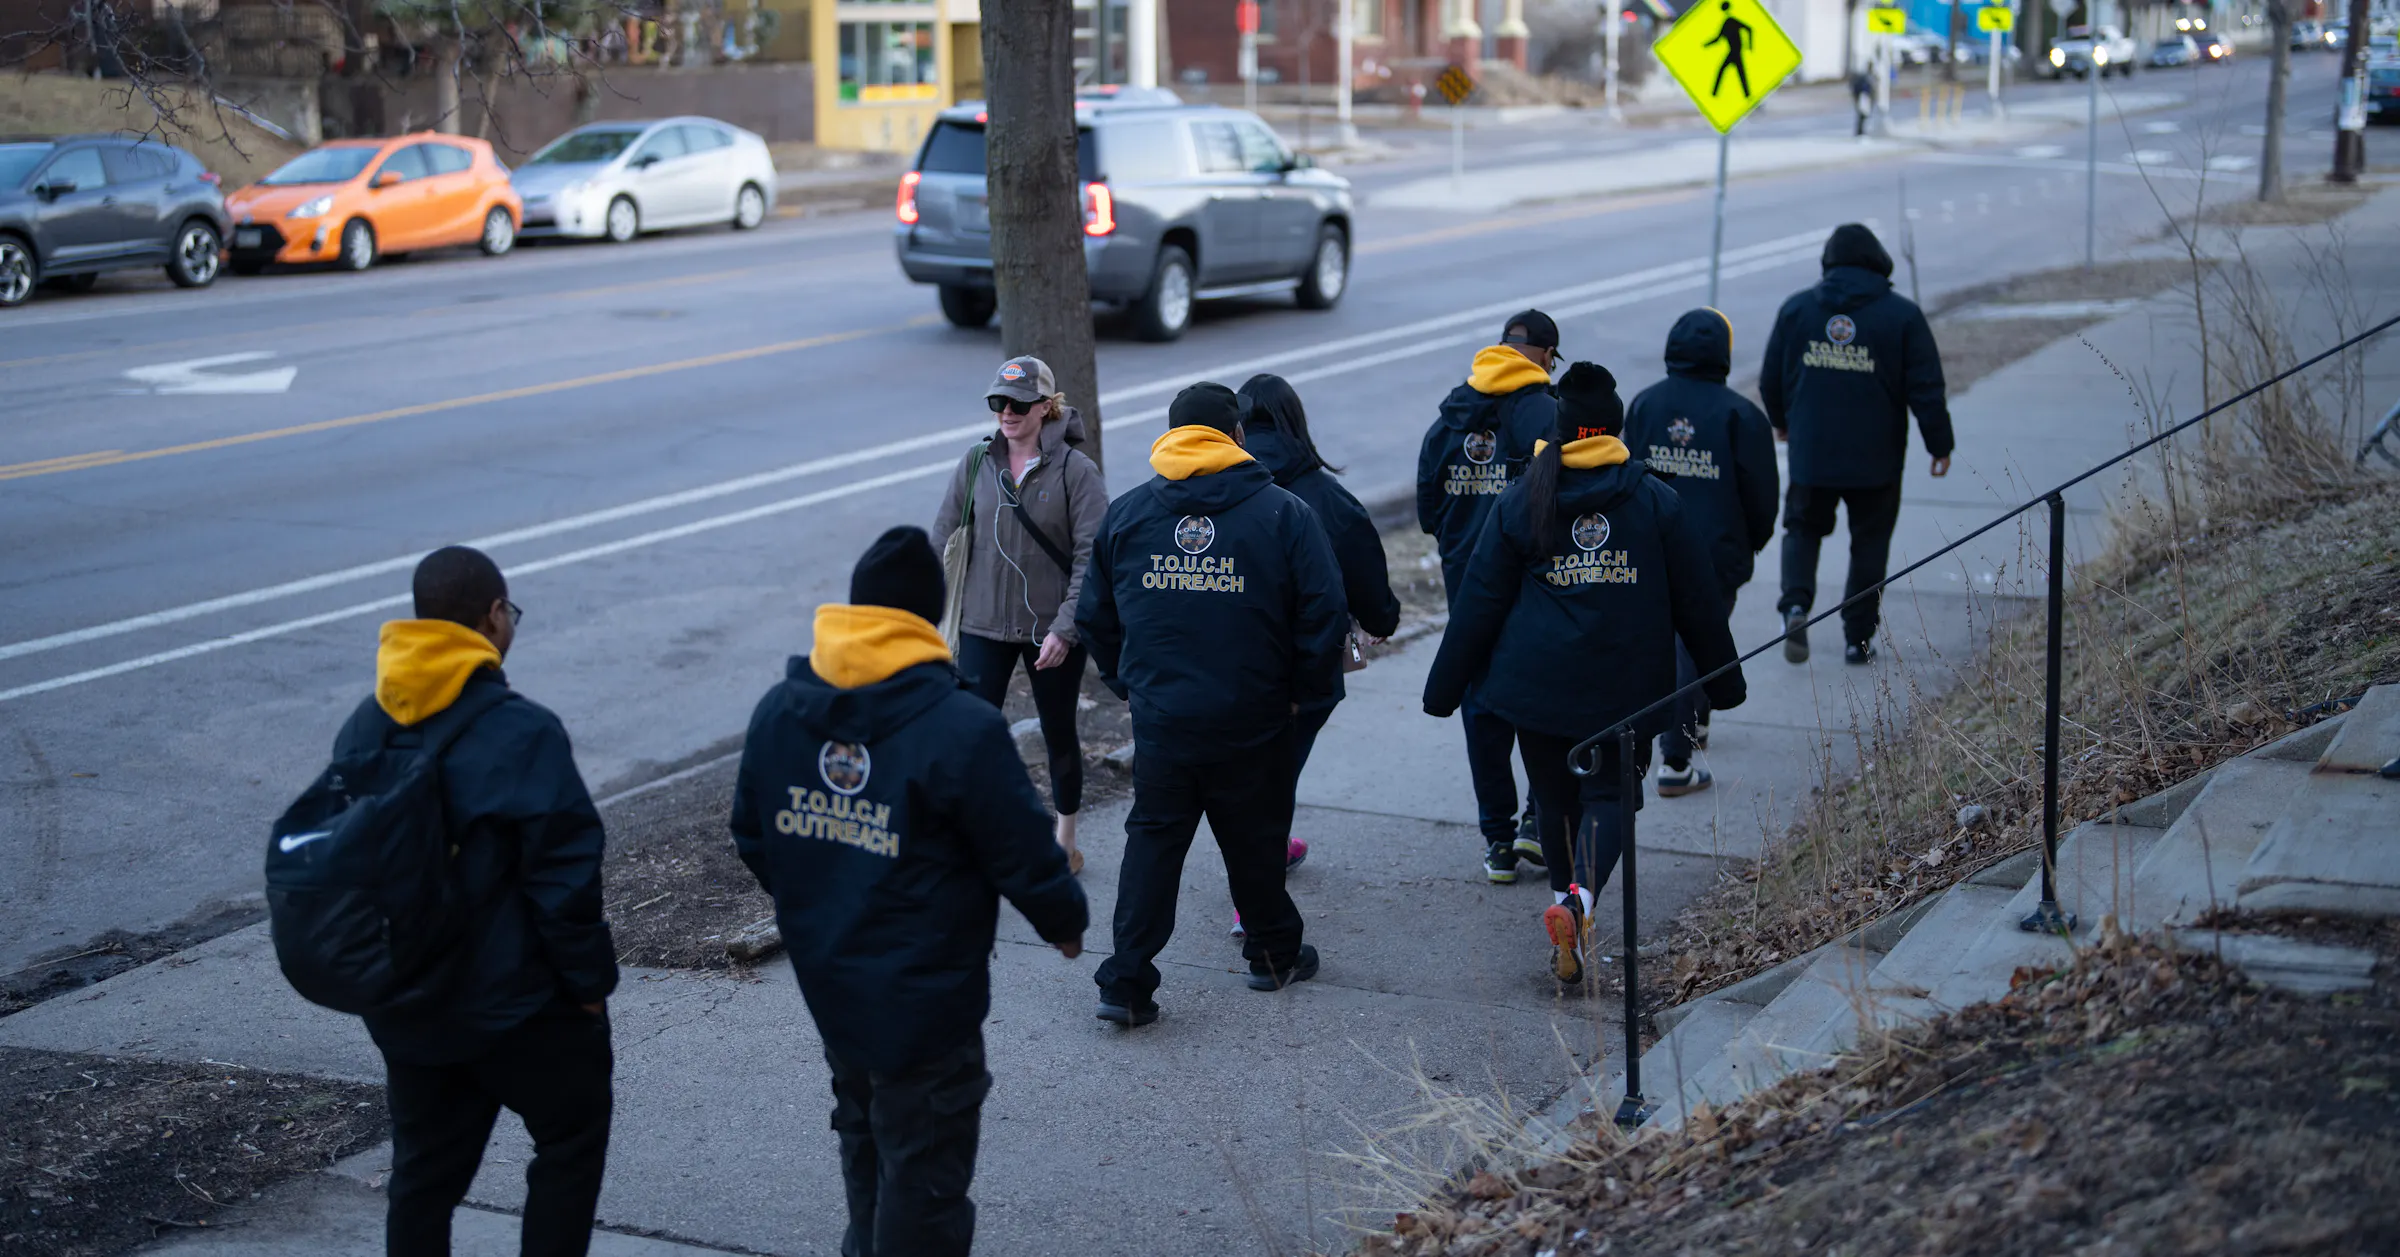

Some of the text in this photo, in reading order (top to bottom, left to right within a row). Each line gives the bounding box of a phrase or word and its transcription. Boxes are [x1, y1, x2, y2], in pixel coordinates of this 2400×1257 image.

[1444, 479, 1508, 495] OUTREAC
[1150, 554, 1235, 574] T.O.U.C.H
[1552, 549, 1628, 571] T.O.U.C.H
[1142, 571, 1245, 593] OUTREACH
[1545, 566, 1638, 587] OUTREACH
[787, 785, 891, 829] T.O.U.C.H
[775, 809, 900, 858] OUTREACH
